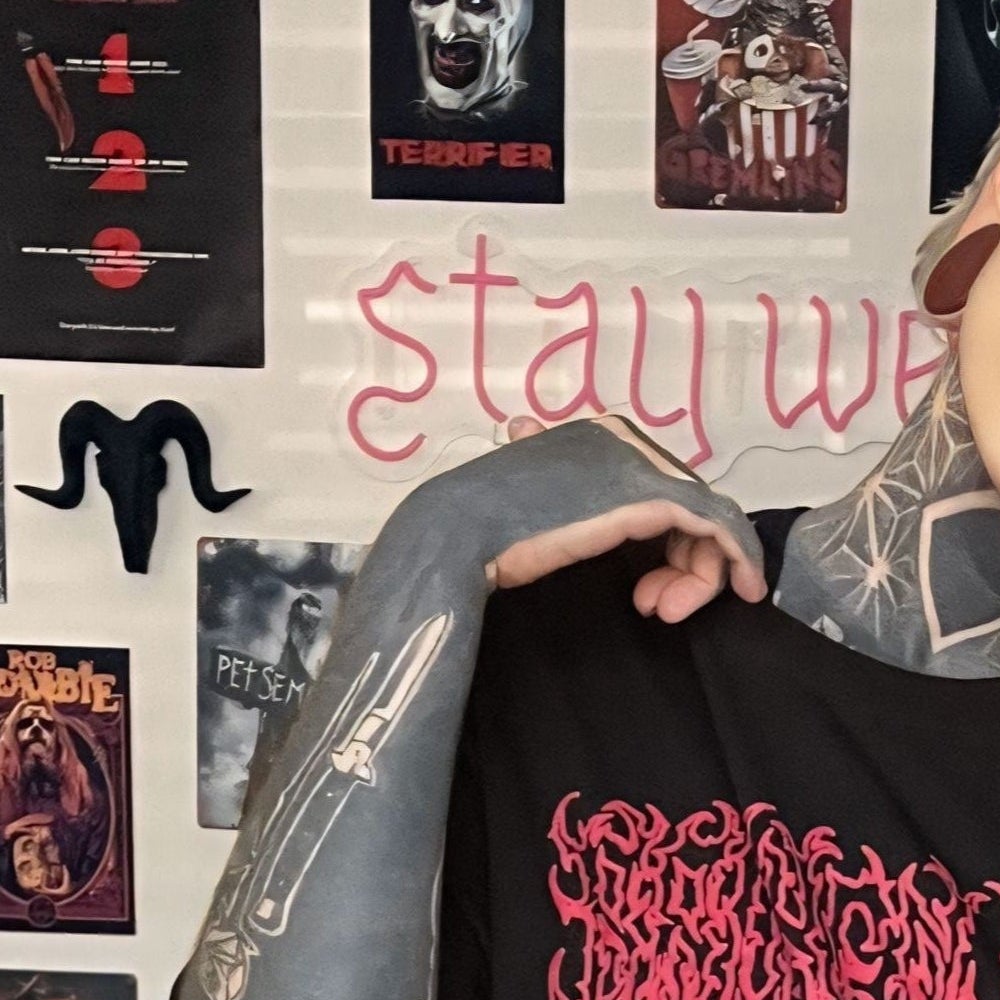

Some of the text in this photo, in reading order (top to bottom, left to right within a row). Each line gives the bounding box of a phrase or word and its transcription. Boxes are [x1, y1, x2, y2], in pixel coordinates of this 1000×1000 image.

[378, 138, 554, 170] TERRIFIER
[347, 234, 714, 469] stay
[7, 649, 57, 671] ROB
